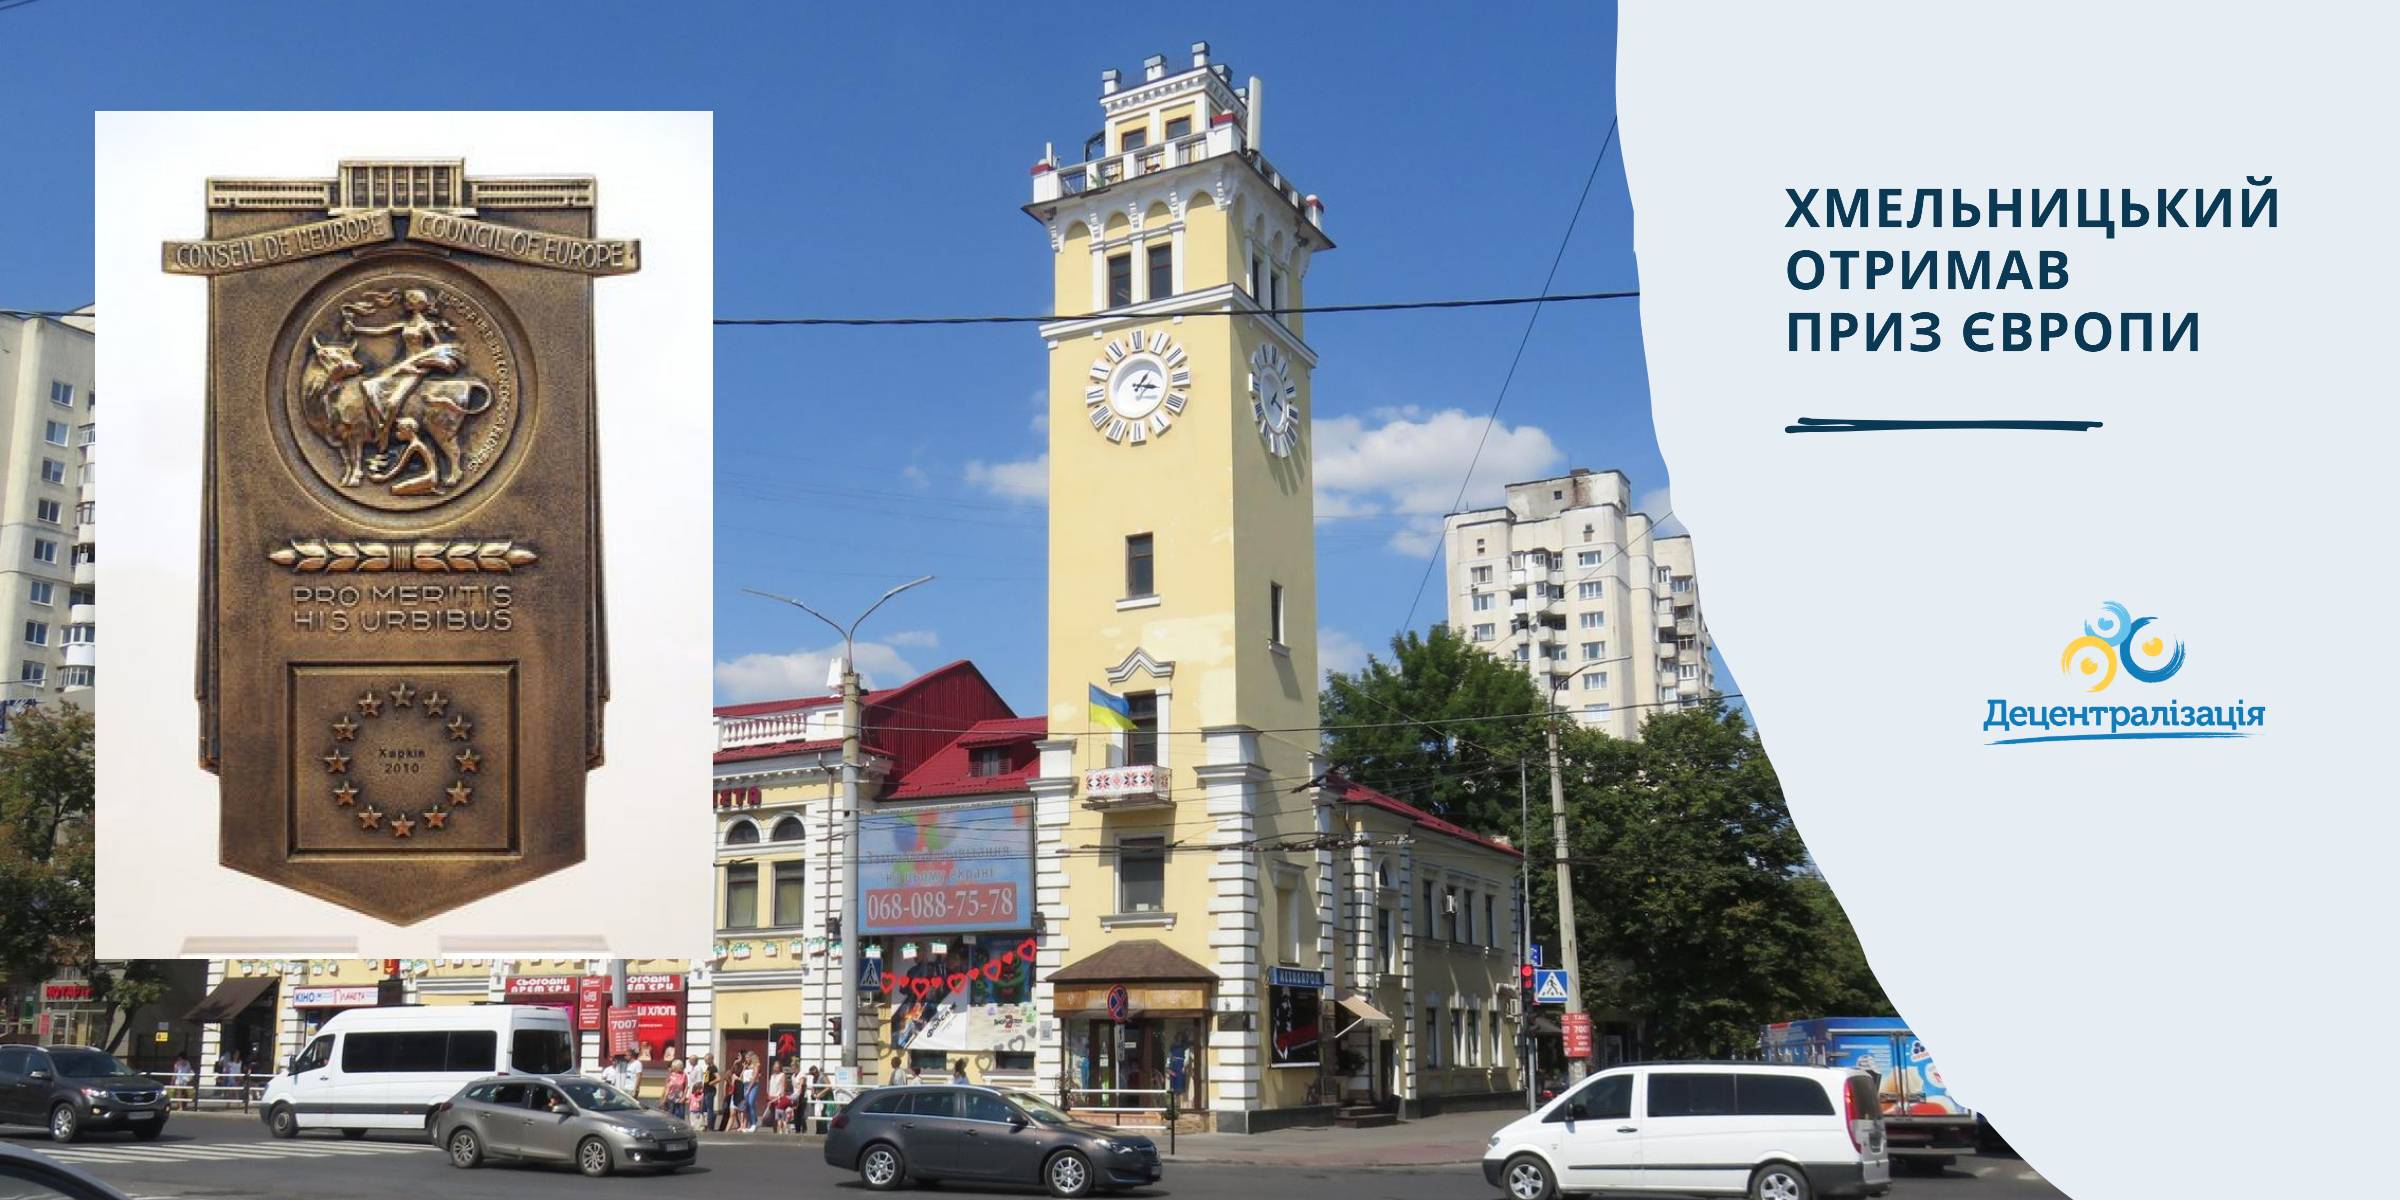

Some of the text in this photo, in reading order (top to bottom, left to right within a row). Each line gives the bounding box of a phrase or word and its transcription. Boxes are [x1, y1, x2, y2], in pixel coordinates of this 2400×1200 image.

[176, 215, 385, 269] CONSEIL DE L'EUROPE
[419, 215, 624, 269] COUNCIL OF EUROPE
[292, 585, 513, 608] PRO MERITIS
[292, 608, 513, 633] HIS URBIBUS
[385, 763, 419, 775] 2010
[868, 887, 1014, 921] 068-088-75-78
[627, 976, 670, 984] ОГОДНІ
[611, 1019, 637, 1030] 7007
